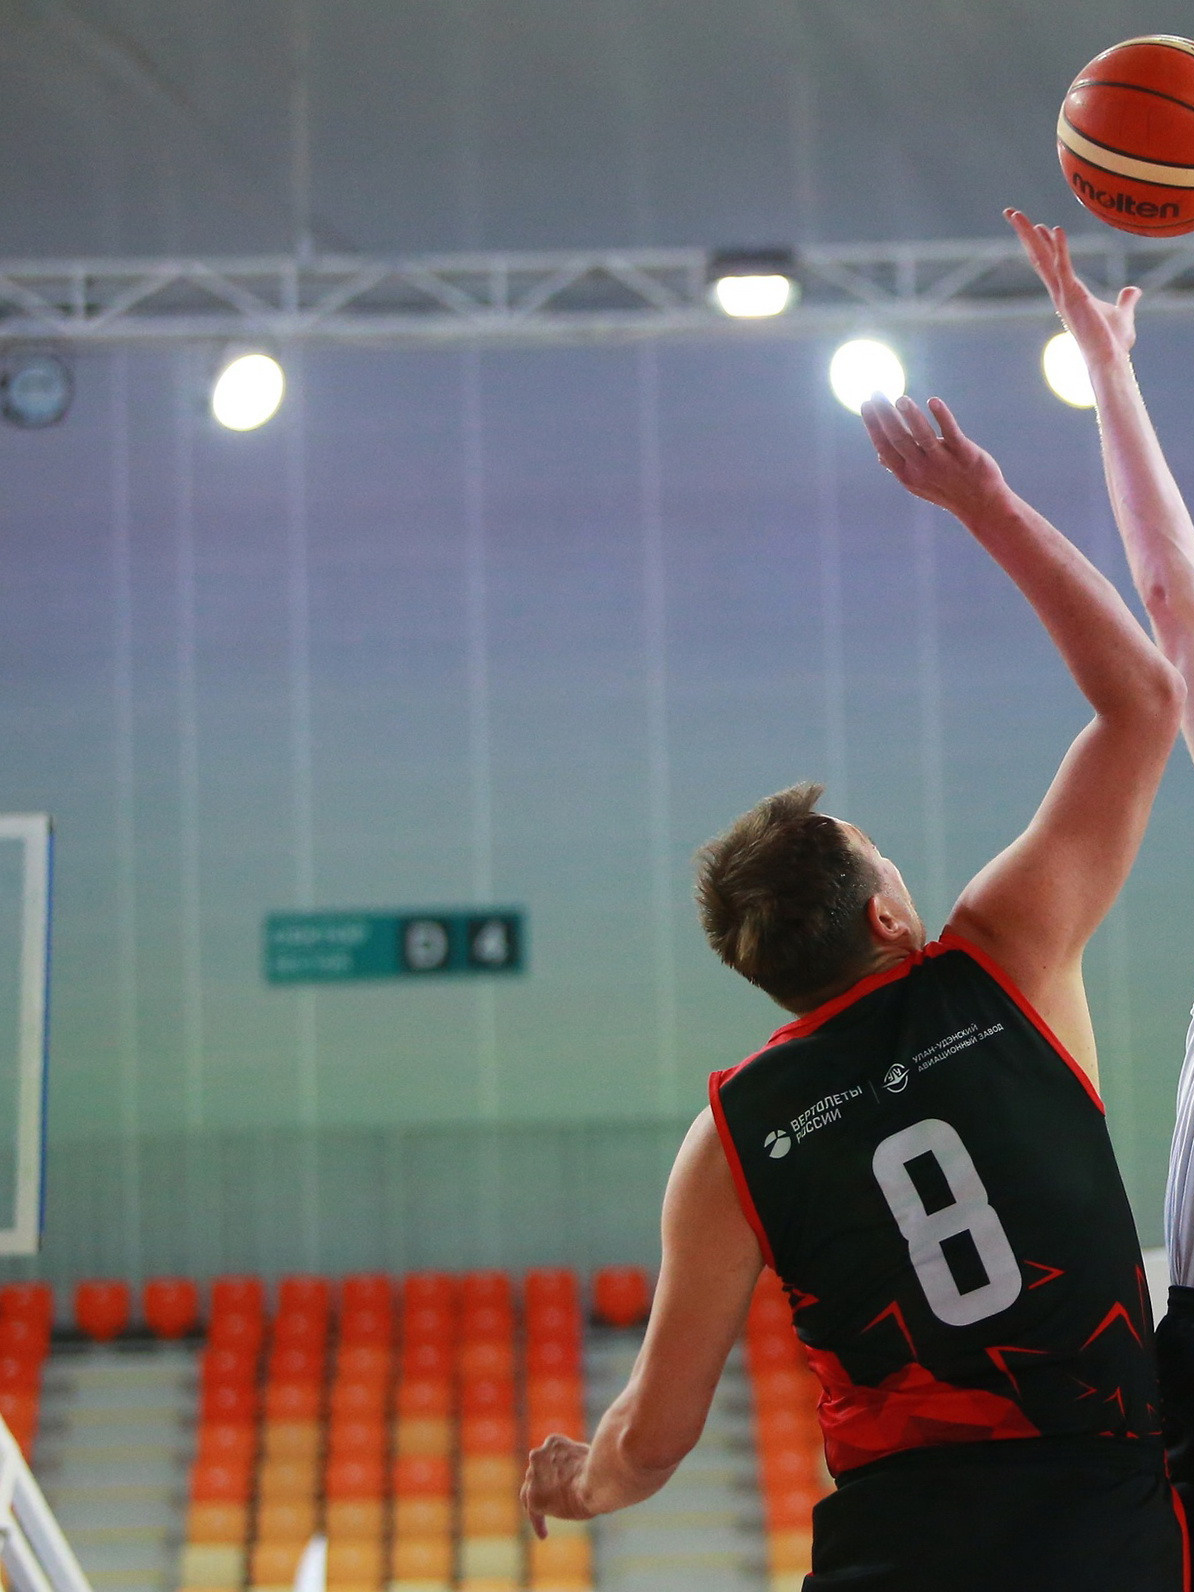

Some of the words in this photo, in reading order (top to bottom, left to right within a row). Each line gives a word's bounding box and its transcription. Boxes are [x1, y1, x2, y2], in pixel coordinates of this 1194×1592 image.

[1073, 173, 1180, 218] molten
[912, 1022, 978, 1063] УЛАН-УДЭНСКИЙ
[918, 1036, 978, 1072] АВИАЦИОННЫЙ
[979, 1023, 1004, 1041] ЗАВОД
[790, 1086, 863, 1132] ВЕРТОЛЕТЫ
[872, 1118, 1022, 1326] 8
